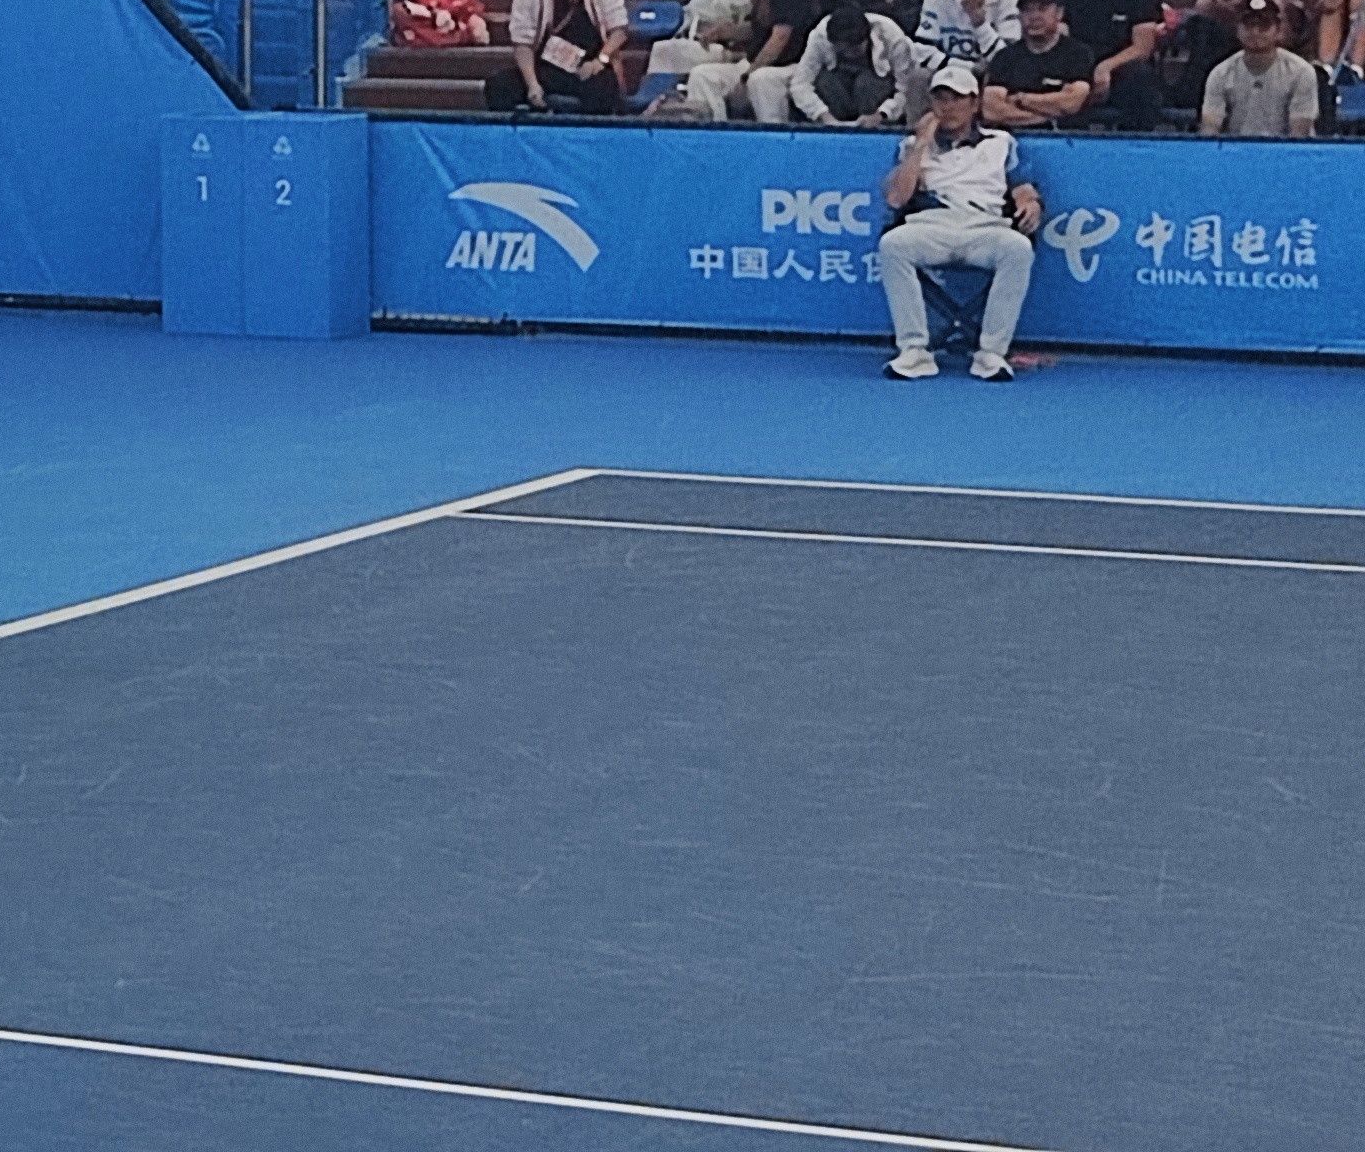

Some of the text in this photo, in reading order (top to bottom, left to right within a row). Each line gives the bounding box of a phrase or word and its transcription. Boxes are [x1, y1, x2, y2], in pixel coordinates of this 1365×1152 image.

[195, 175, 208, 202] 1
[275, 179, 293, 206] 2
[761, 189, 871, 236] PICC
[445, 230, 536, 272] ANTA
[1135, 210, 1319, 268] 中国电信
[1136, 267, 1320, 290] CHINA TELECOM
